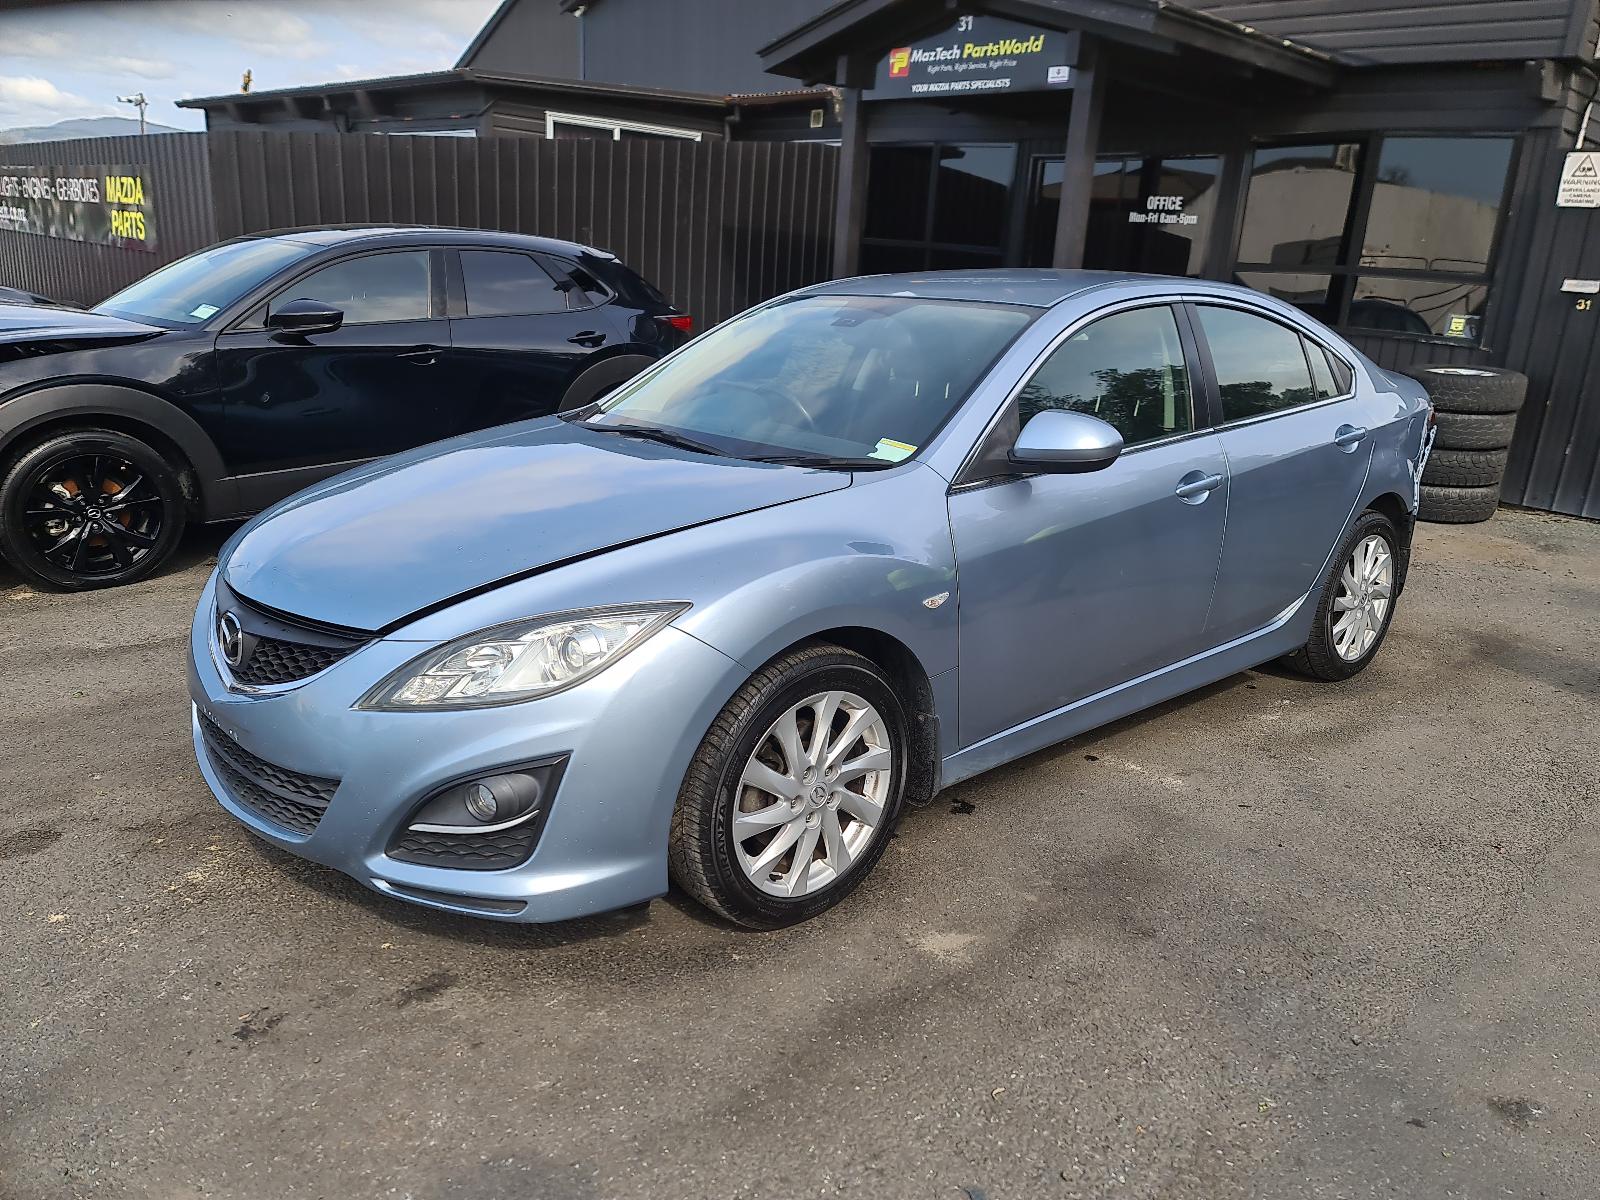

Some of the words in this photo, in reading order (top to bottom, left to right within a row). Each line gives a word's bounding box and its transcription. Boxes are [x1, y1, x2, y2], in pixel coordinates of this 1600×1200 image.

[958, 15, 974, 31] 31
[911, 44, 960, 63] MazTech
[962, 33, 1045, 59] PartsWorld
[911, 84, 928, 93] YOUR
[929, 82, 950, 92] MAZDA
[950, 80, 970, 91] PARTS
[970, 78, 1011, 90] SPECIALISTS
[105, 175, 145, 206] MAZDA
[1146, 196, 1184, 211] OFFICE
[1128, 211, 1159, 223] Mon-Fri
[111, 209, 145, 241] PARTS
[1575, 299, 1591, 311] 31
